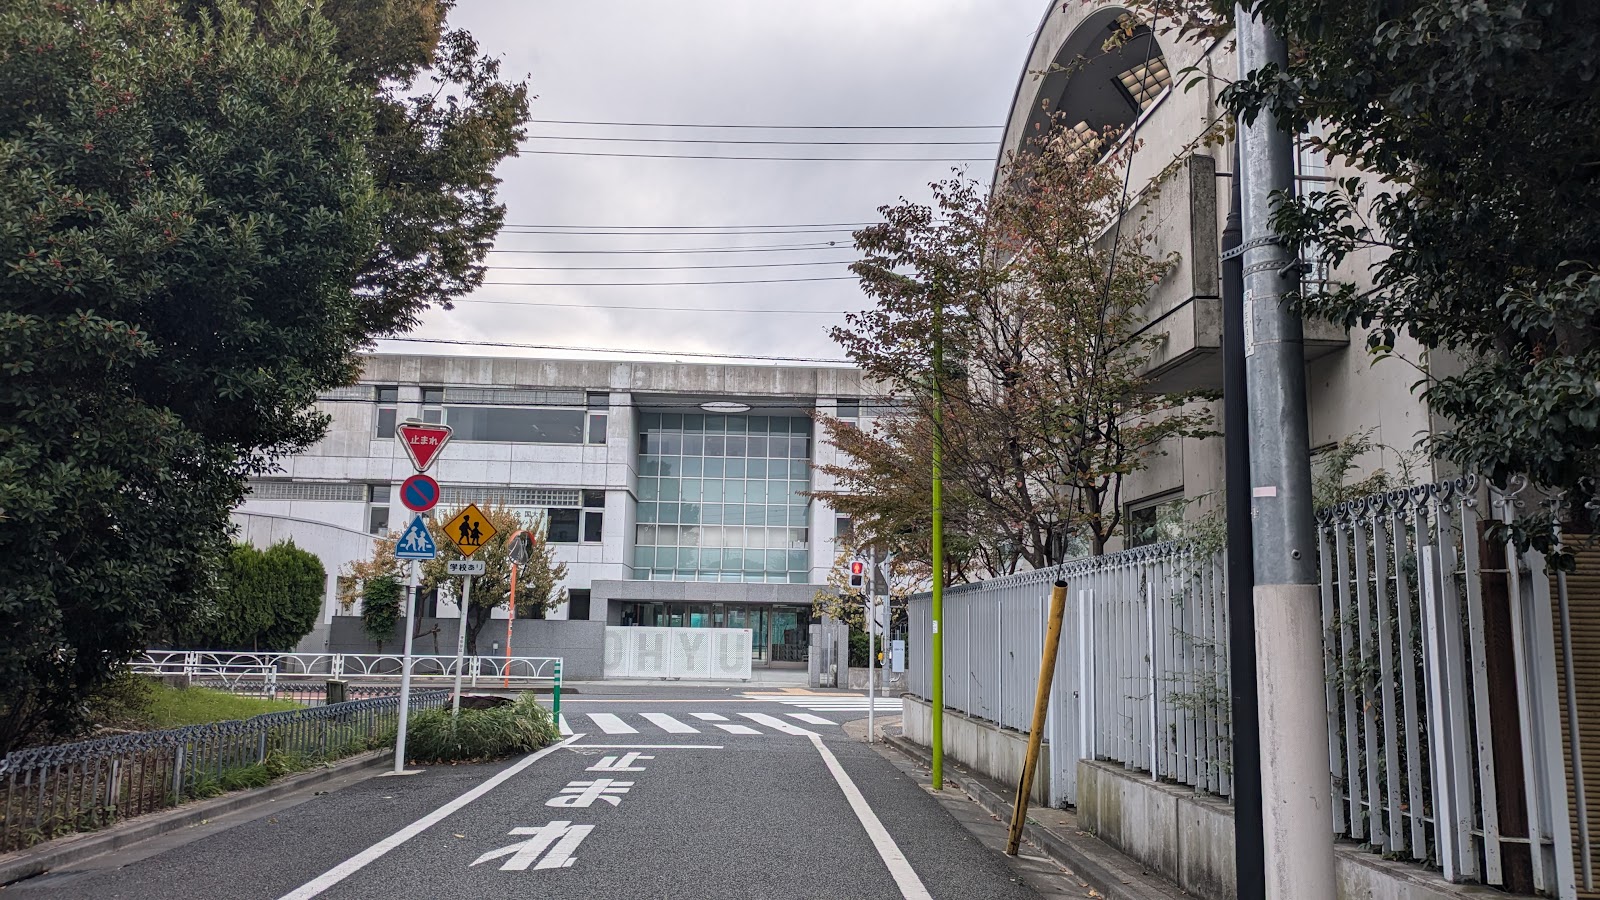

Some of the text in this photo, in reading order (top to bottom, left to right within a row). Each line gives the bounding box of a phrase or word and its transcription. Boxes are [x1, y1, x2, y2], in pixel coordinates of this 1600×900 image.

[410, 435, 438, 445] 止まれ
[450, 563, 483, 572] 学校あり
[468, 751, 655, 871] 止まれ
